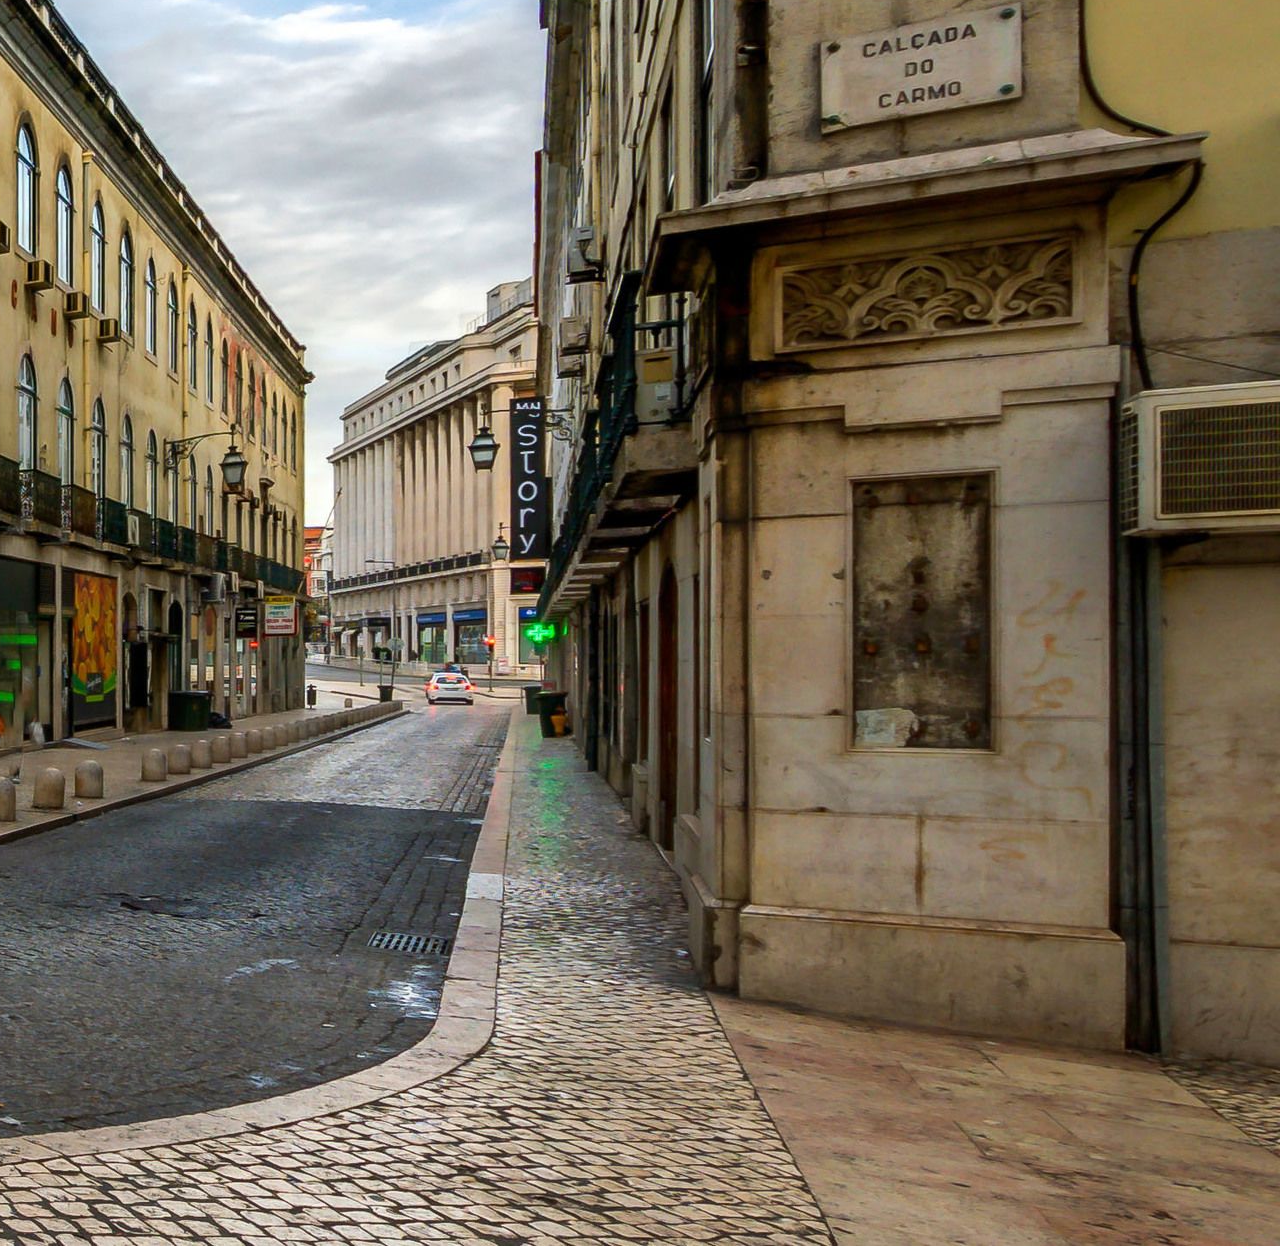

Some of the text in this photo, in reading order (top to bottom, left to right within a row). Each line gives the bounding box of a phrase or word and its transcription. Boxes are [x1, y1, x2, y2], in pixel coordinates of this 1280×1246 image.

[862, 23, 977, 58] CALÇADA
[904, 58, 934, 78] DO
[878, 81, 962, 109] CARMO
[517, 424, 538, 555] Story
